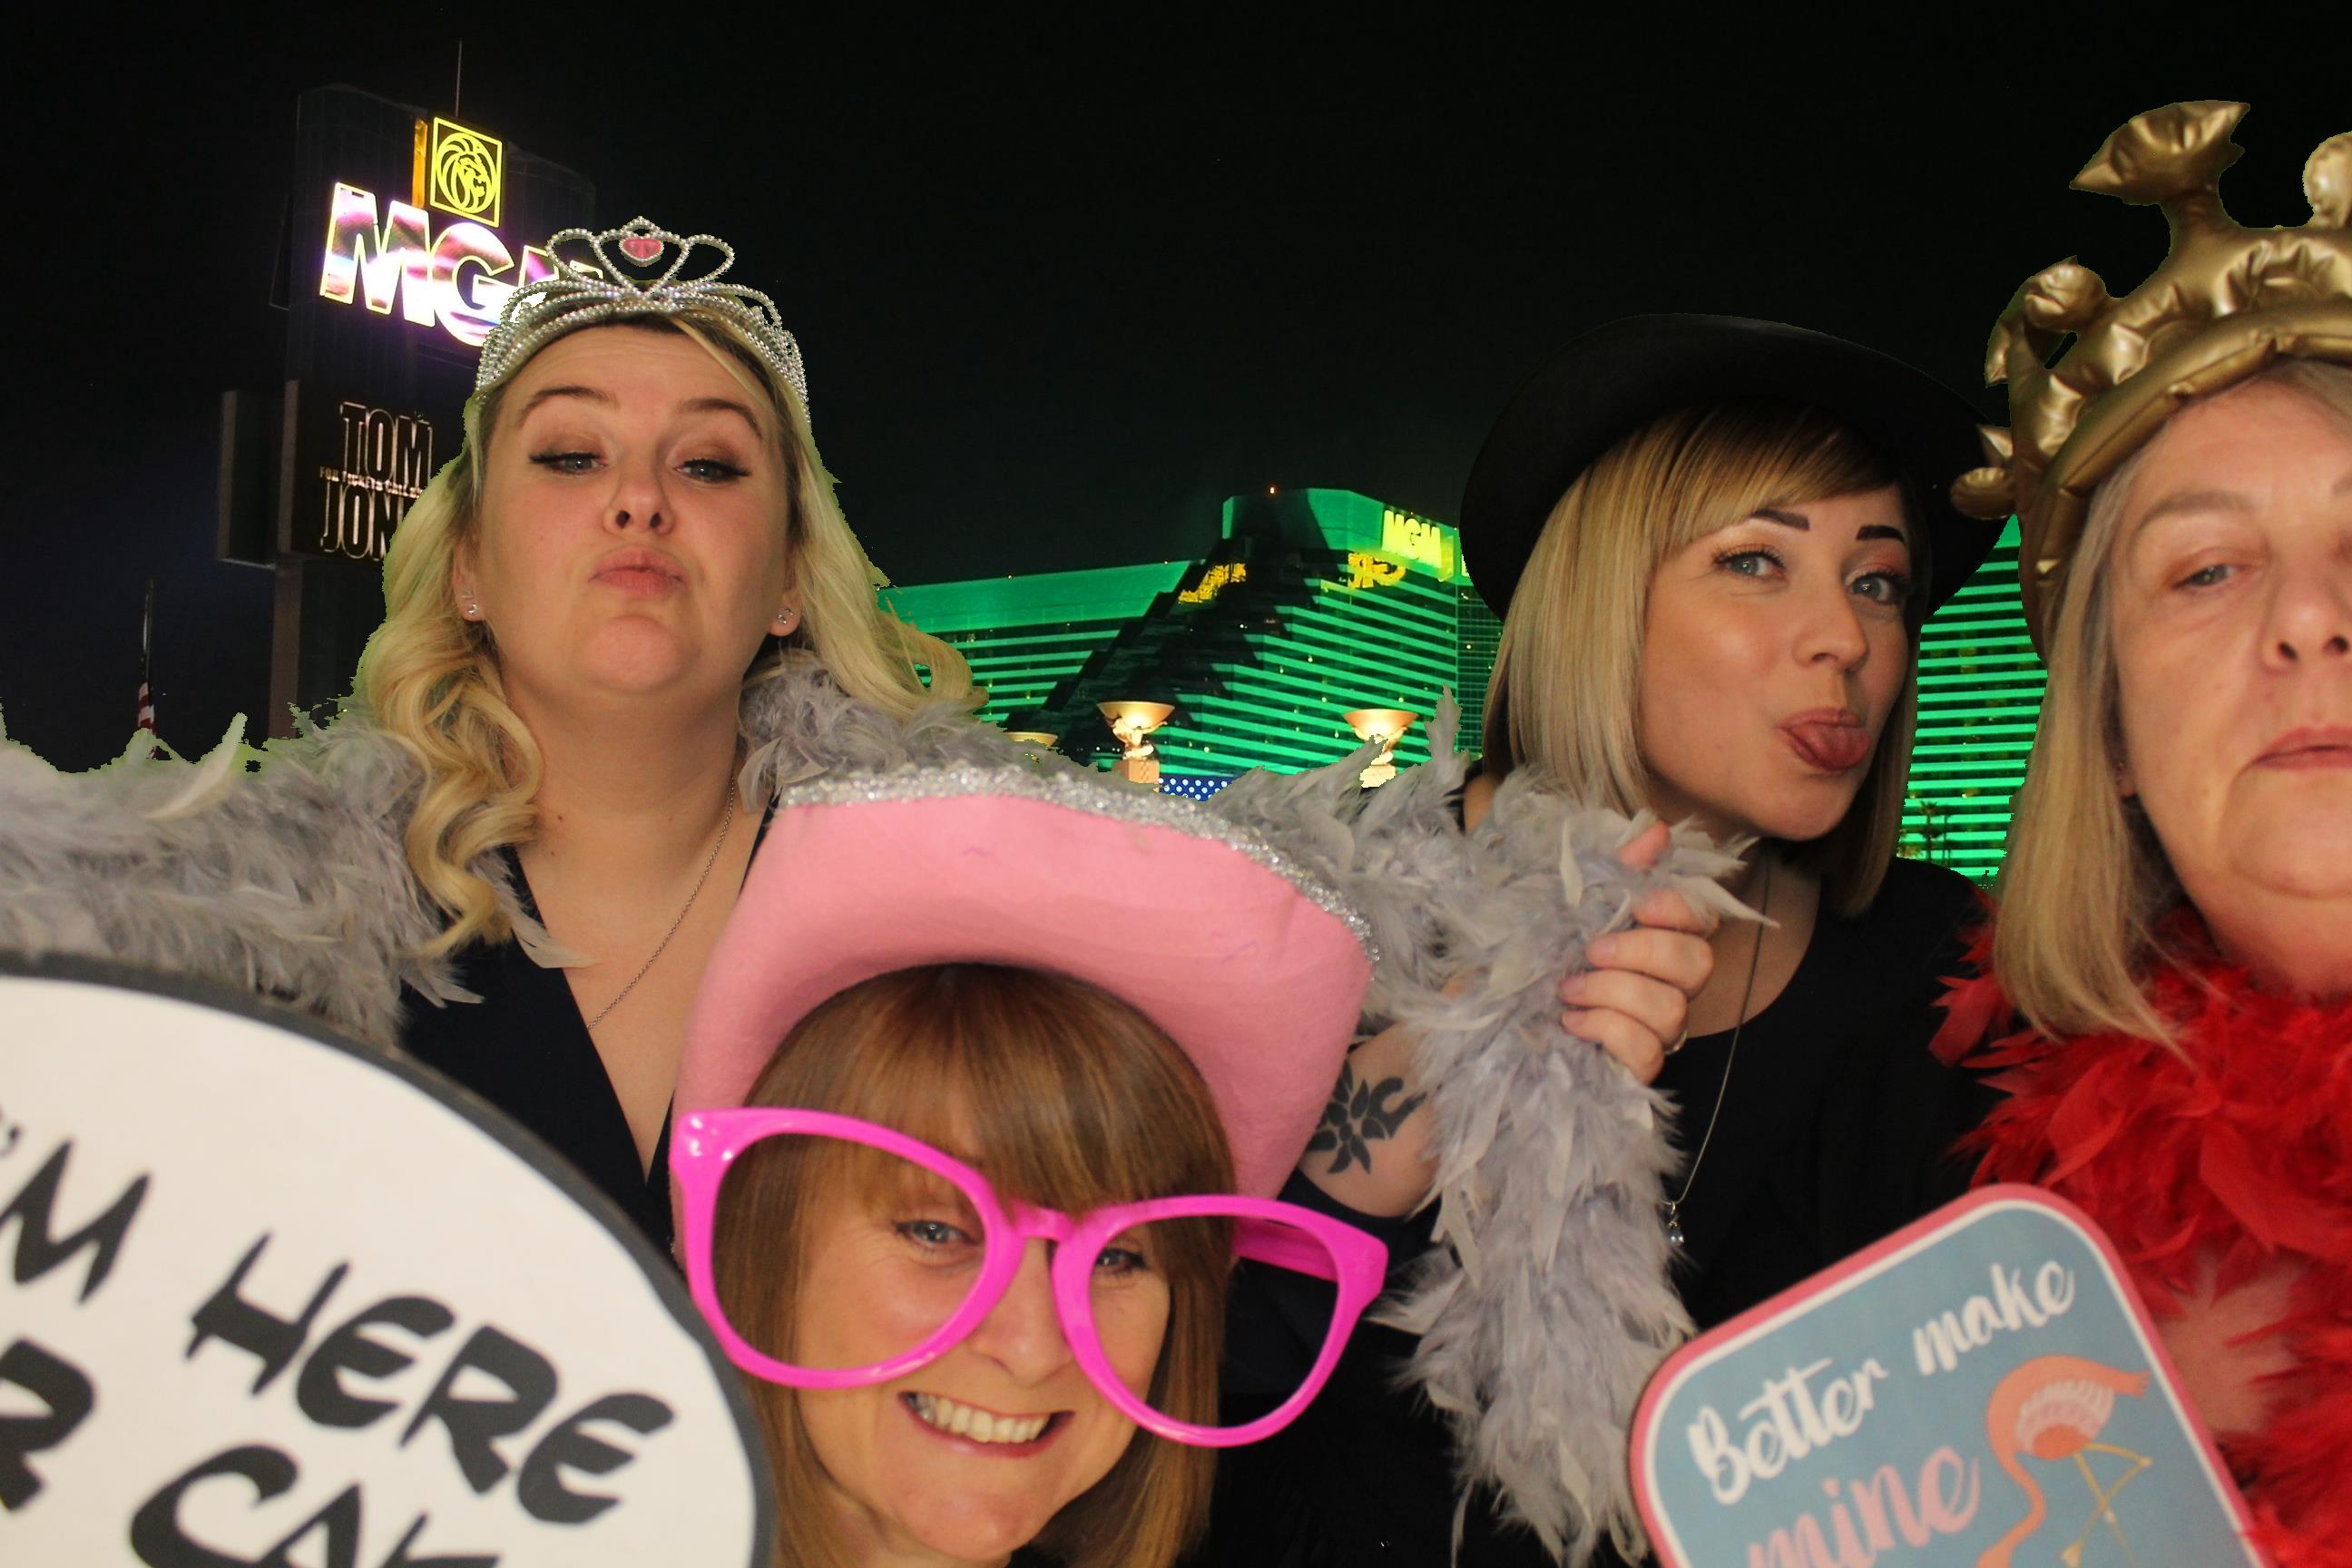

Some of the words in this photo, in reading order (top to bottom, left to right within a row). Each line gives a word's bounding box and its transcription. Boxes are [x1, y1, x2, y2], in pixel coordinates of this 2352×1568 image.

[340, 402, 433, 488] TOM
[1382, 510, 1442, 568] MGM
[185, 1230, 676, 1525] HERE
[1687, 1358, 1887, 1504] Better
[1914, 1260, 2074, 1375] make
